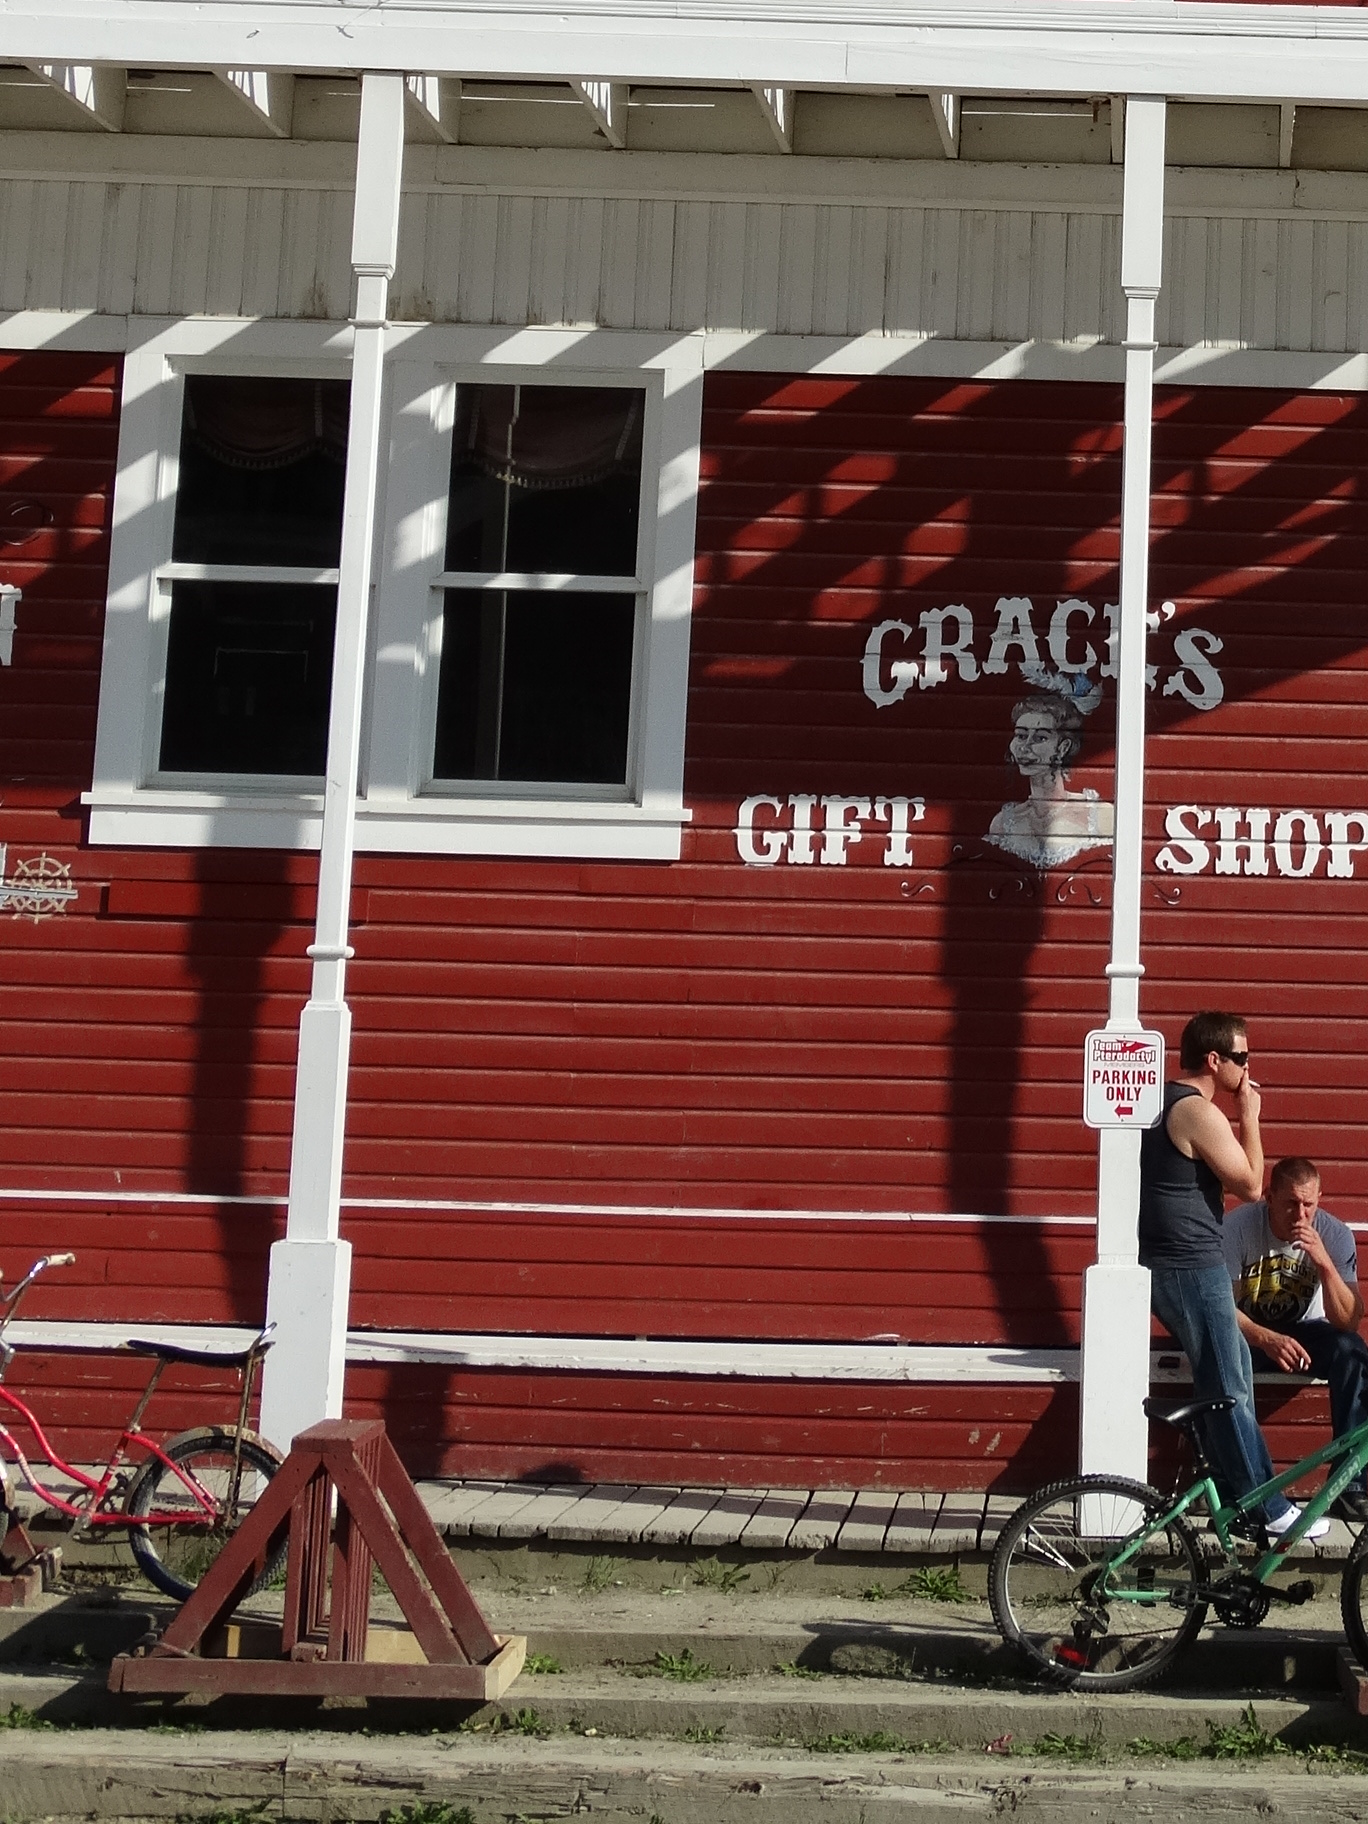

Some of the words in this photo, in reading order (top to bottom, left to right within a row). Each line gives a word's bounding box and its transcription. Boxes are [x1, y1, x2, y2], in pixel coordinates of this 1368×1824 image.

[732, 793, 926, 867] GIFT
[1092, 1039, 1122, 1052] Team
[1092, 1050, 1157, 1064] Pterodactyl
[1092, 1070, 1157, 1085] PARKING
[1106, 1087, 1142, 1101] ONLY
